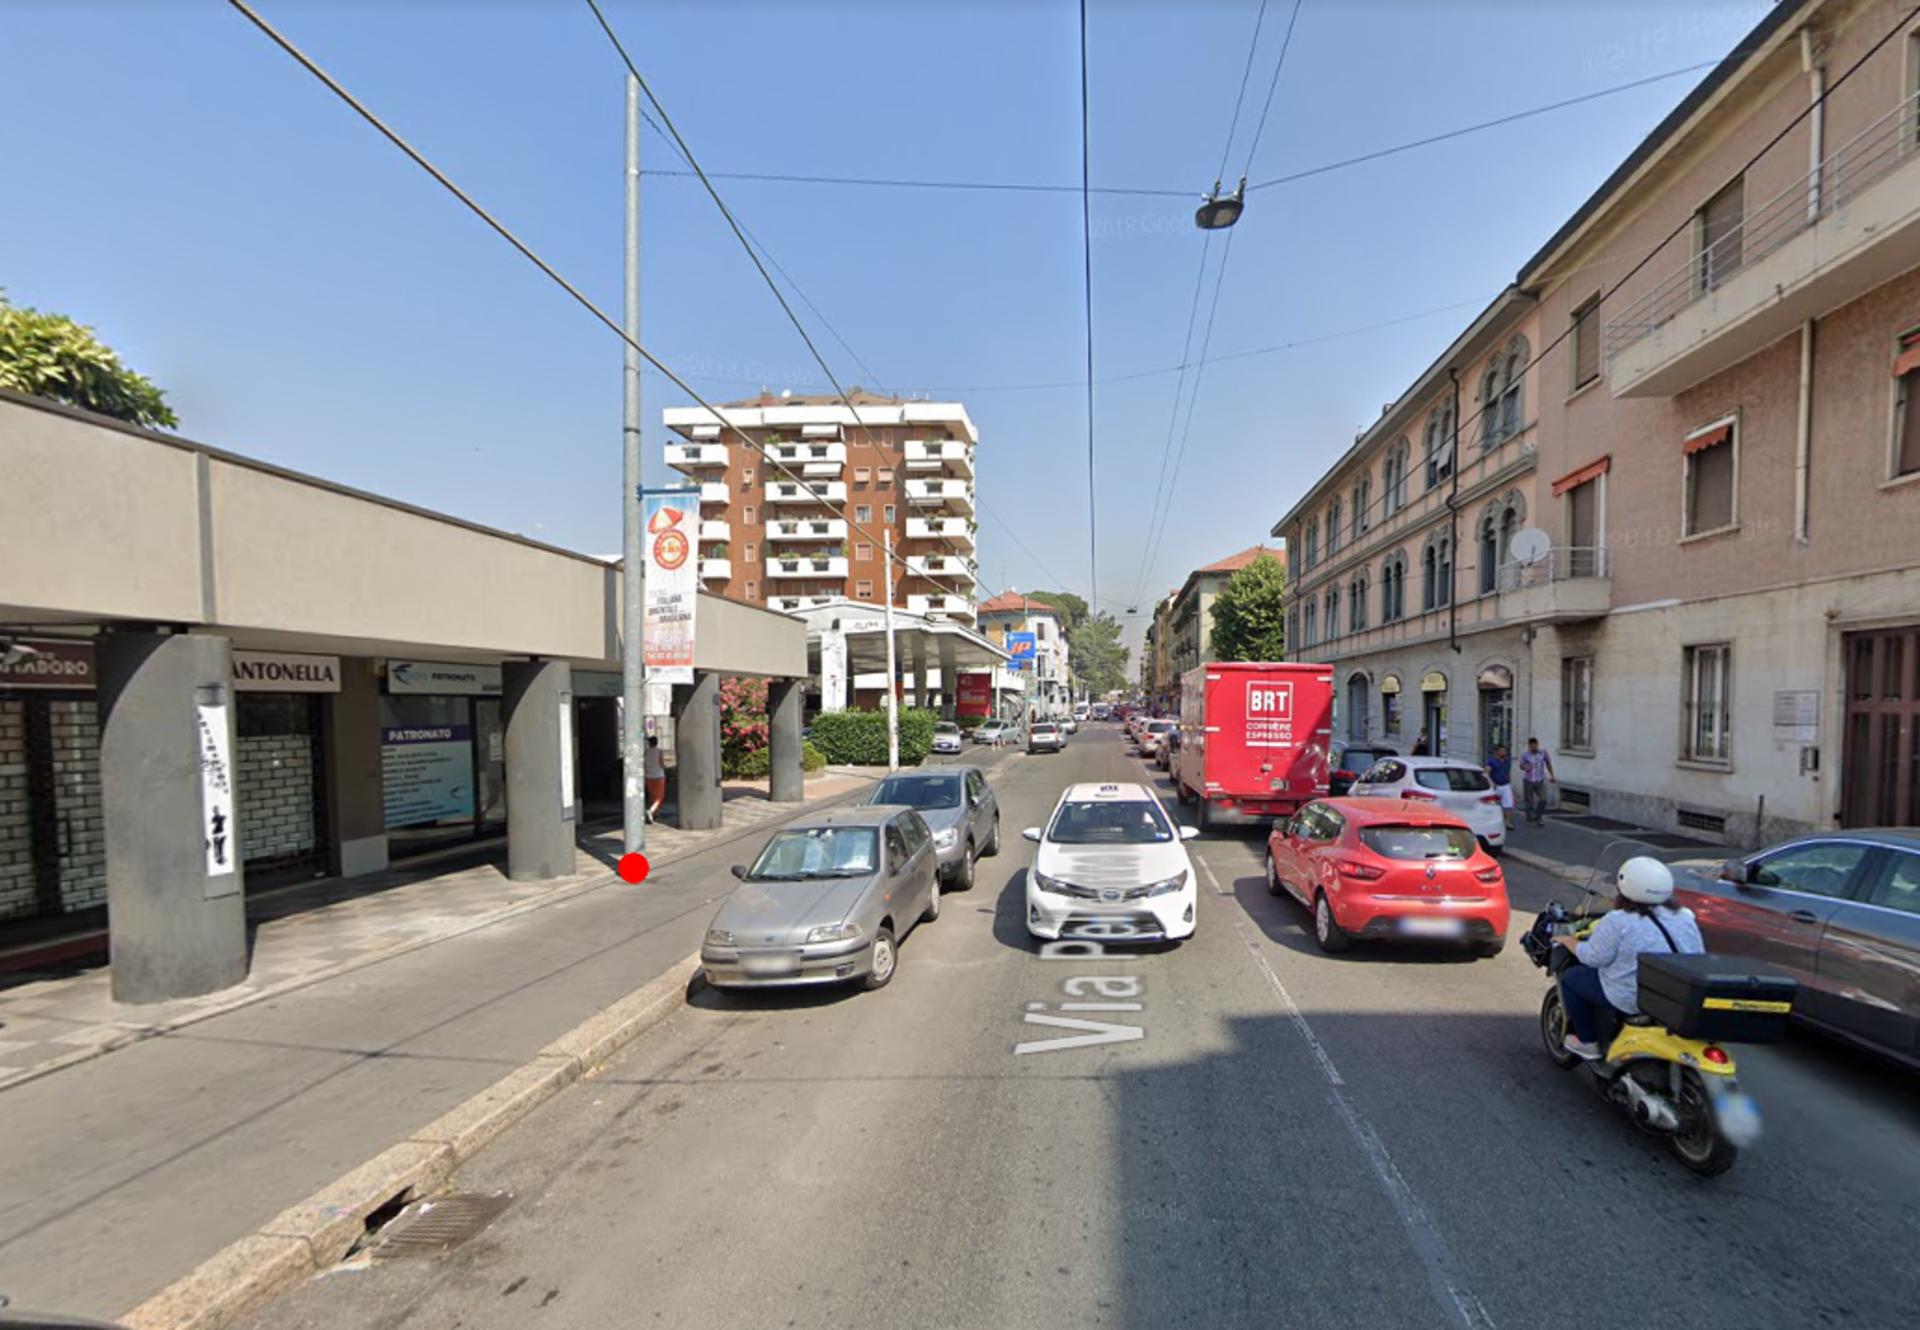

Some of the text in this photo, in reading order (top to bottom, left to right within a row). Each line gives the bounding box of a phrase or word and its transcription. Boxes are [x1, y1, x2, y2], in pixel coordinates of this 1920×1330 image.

[232, 661, 334, 682] ANTONELLA
[431, 672, 477, 682] PATRONATO
[1251, 690, 1289, 712] BRT
[1246, 722, 1292, 731] CORRIERE
[388, 728, 452, 741] PATRONATO
[1246, 731, 1292, 740] ESPRESSO
